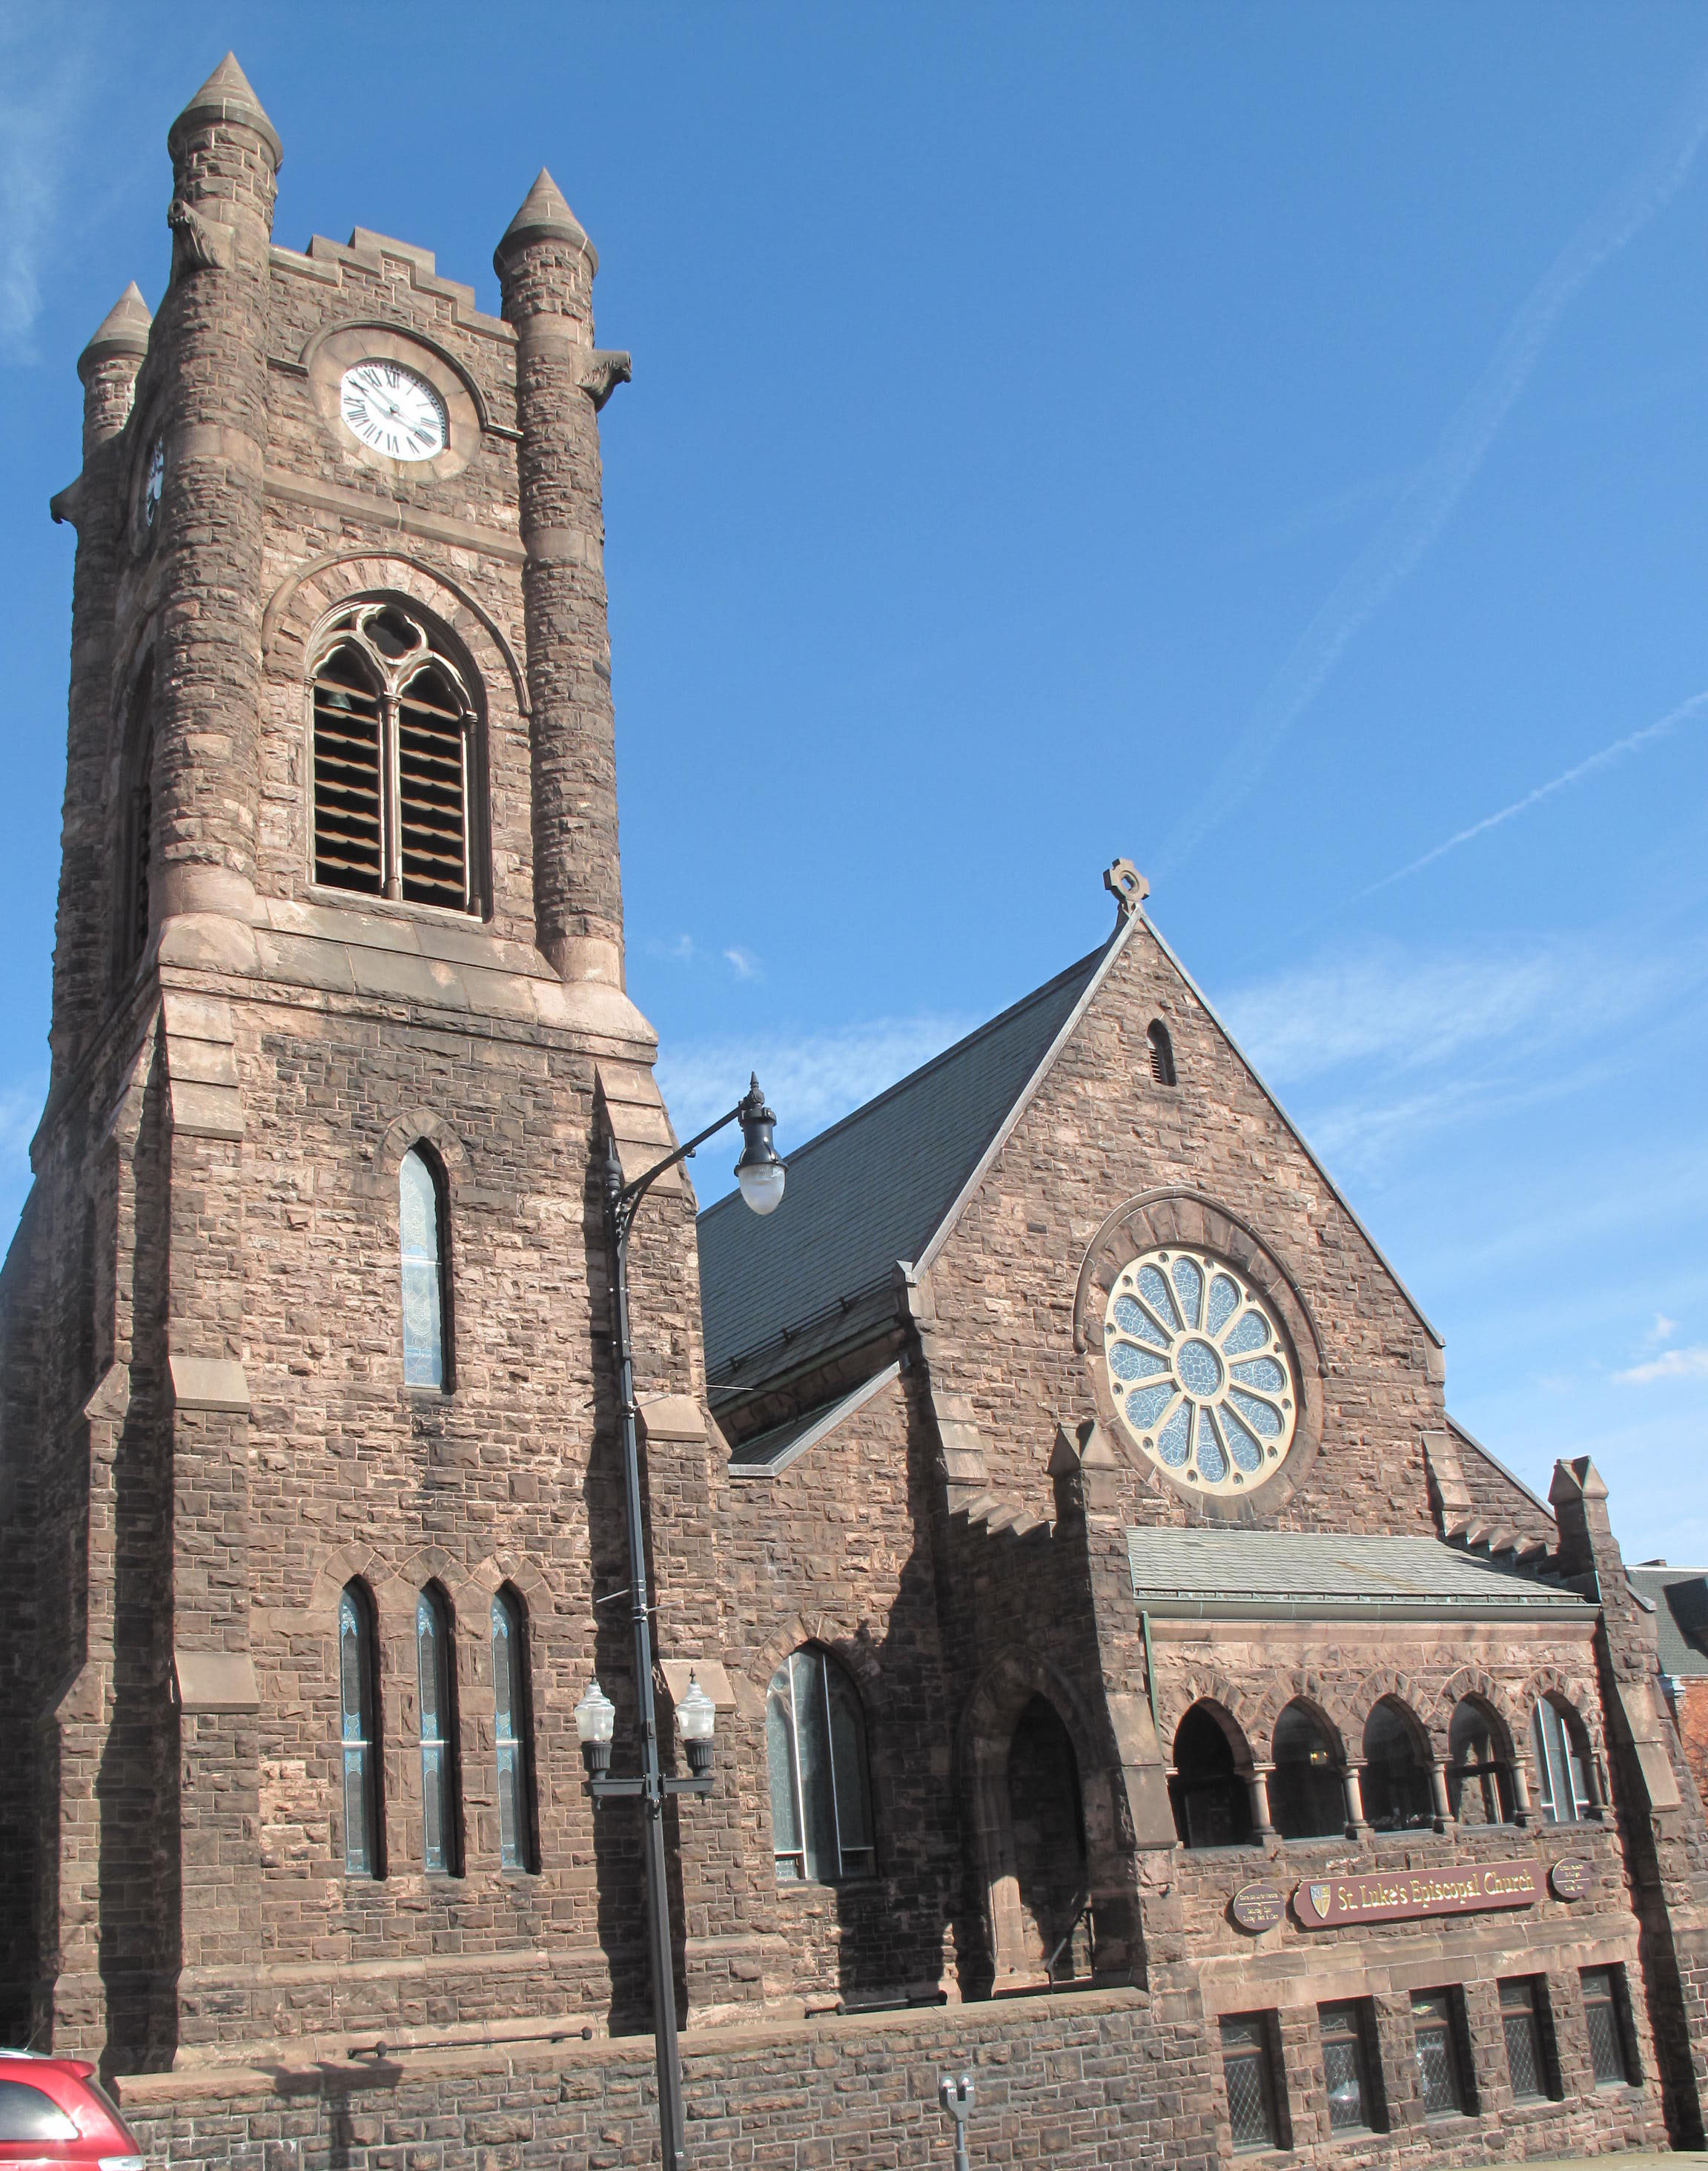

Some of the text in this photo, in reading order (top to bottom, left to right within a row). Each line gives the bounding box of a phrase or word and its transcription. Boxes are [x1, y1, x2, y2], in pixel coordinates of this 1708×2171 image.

[384, 369, 401, 389] XII
[1359, 1883, 1409, 1909] Luke's
[1409, 1872, 1482, 1909] Episcopal
[1483, 1868, 1536, 1895] Church
